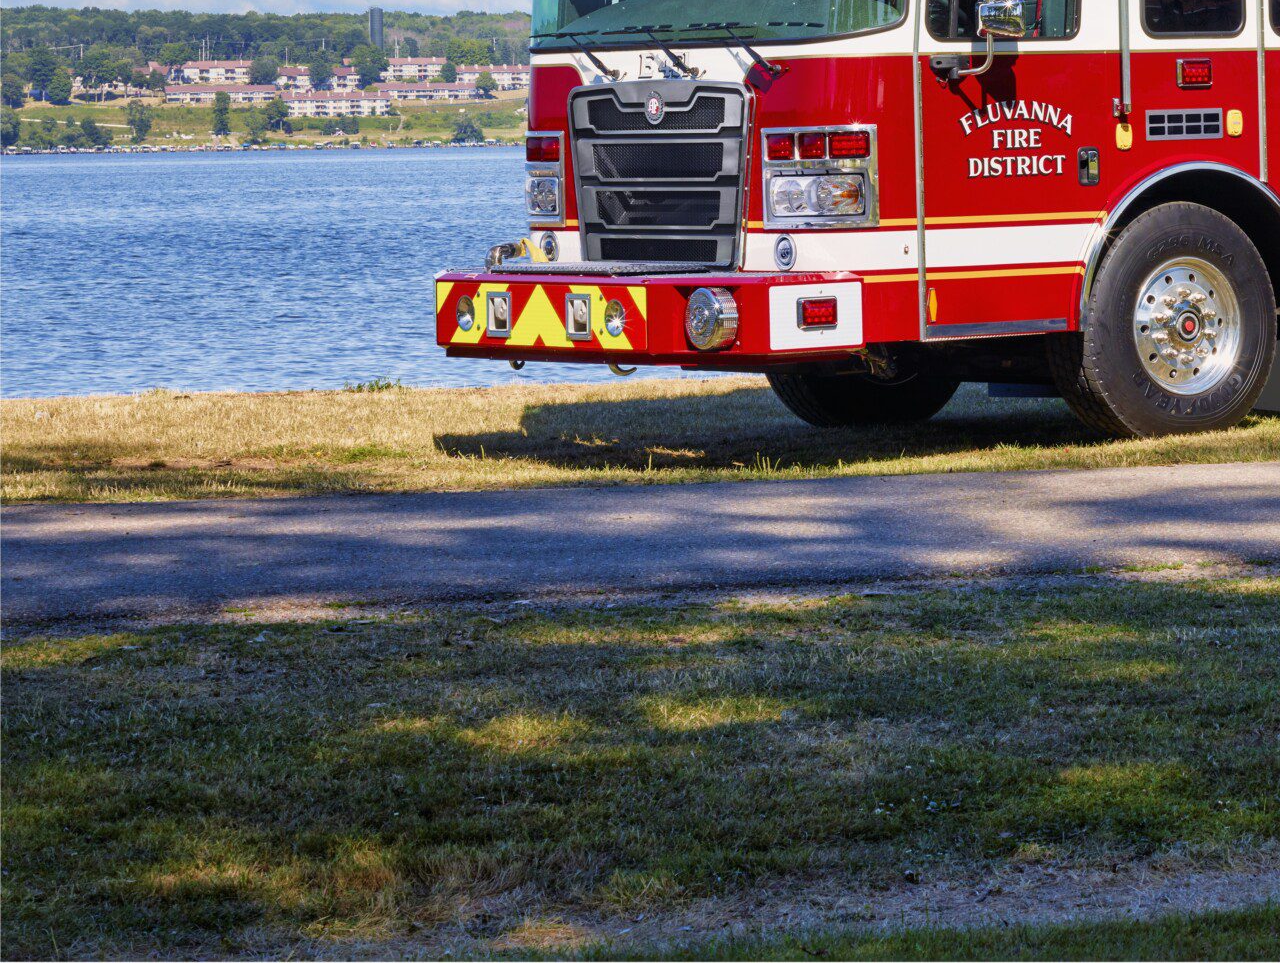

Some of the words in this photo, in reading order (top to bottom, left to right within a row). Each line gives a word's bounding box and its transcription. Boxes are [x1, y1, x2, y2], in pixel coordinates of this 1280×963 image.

[959, 100, 1073, 137] FLUVANNA
[992, 128, 1042, 149] FIRE
[968, 155, 1066, 177] DISTRICT
